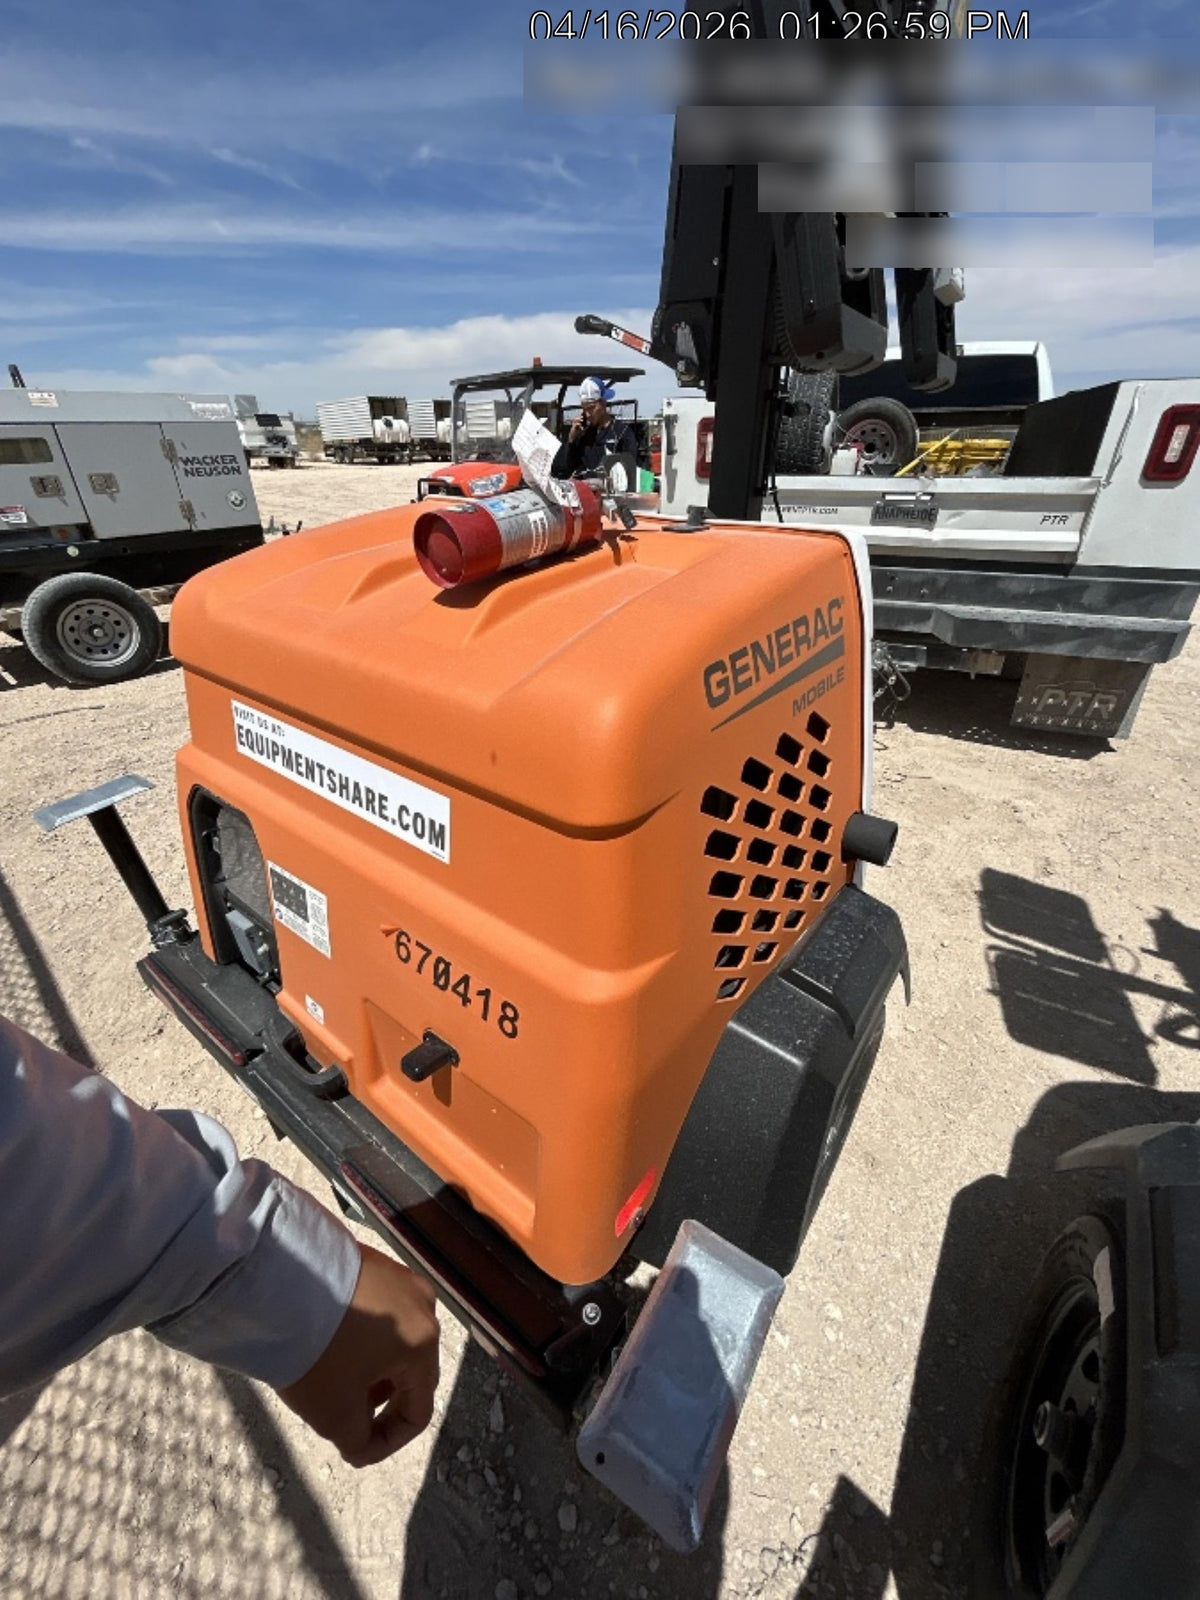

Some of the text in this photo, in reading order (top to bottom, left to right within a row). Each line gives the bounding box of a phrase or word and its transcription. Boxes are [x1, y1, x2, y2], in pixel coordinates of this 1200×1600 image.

[180, 455, 239, 466] WACKER
[184, 466, 241, 477] NEUSON
[1040, 515, 1070, 525] PTR
[703, 598, 844, 709] GENERAC
[792, 666, 845, 717] MOBILE
[1036, 689, 1118, 719] PTR
[257, 716, 269, 730] US
[236, 723, 446, 852] EQUIPMENTSHARE.COM
[395, 930, 520, 1039] 670418
